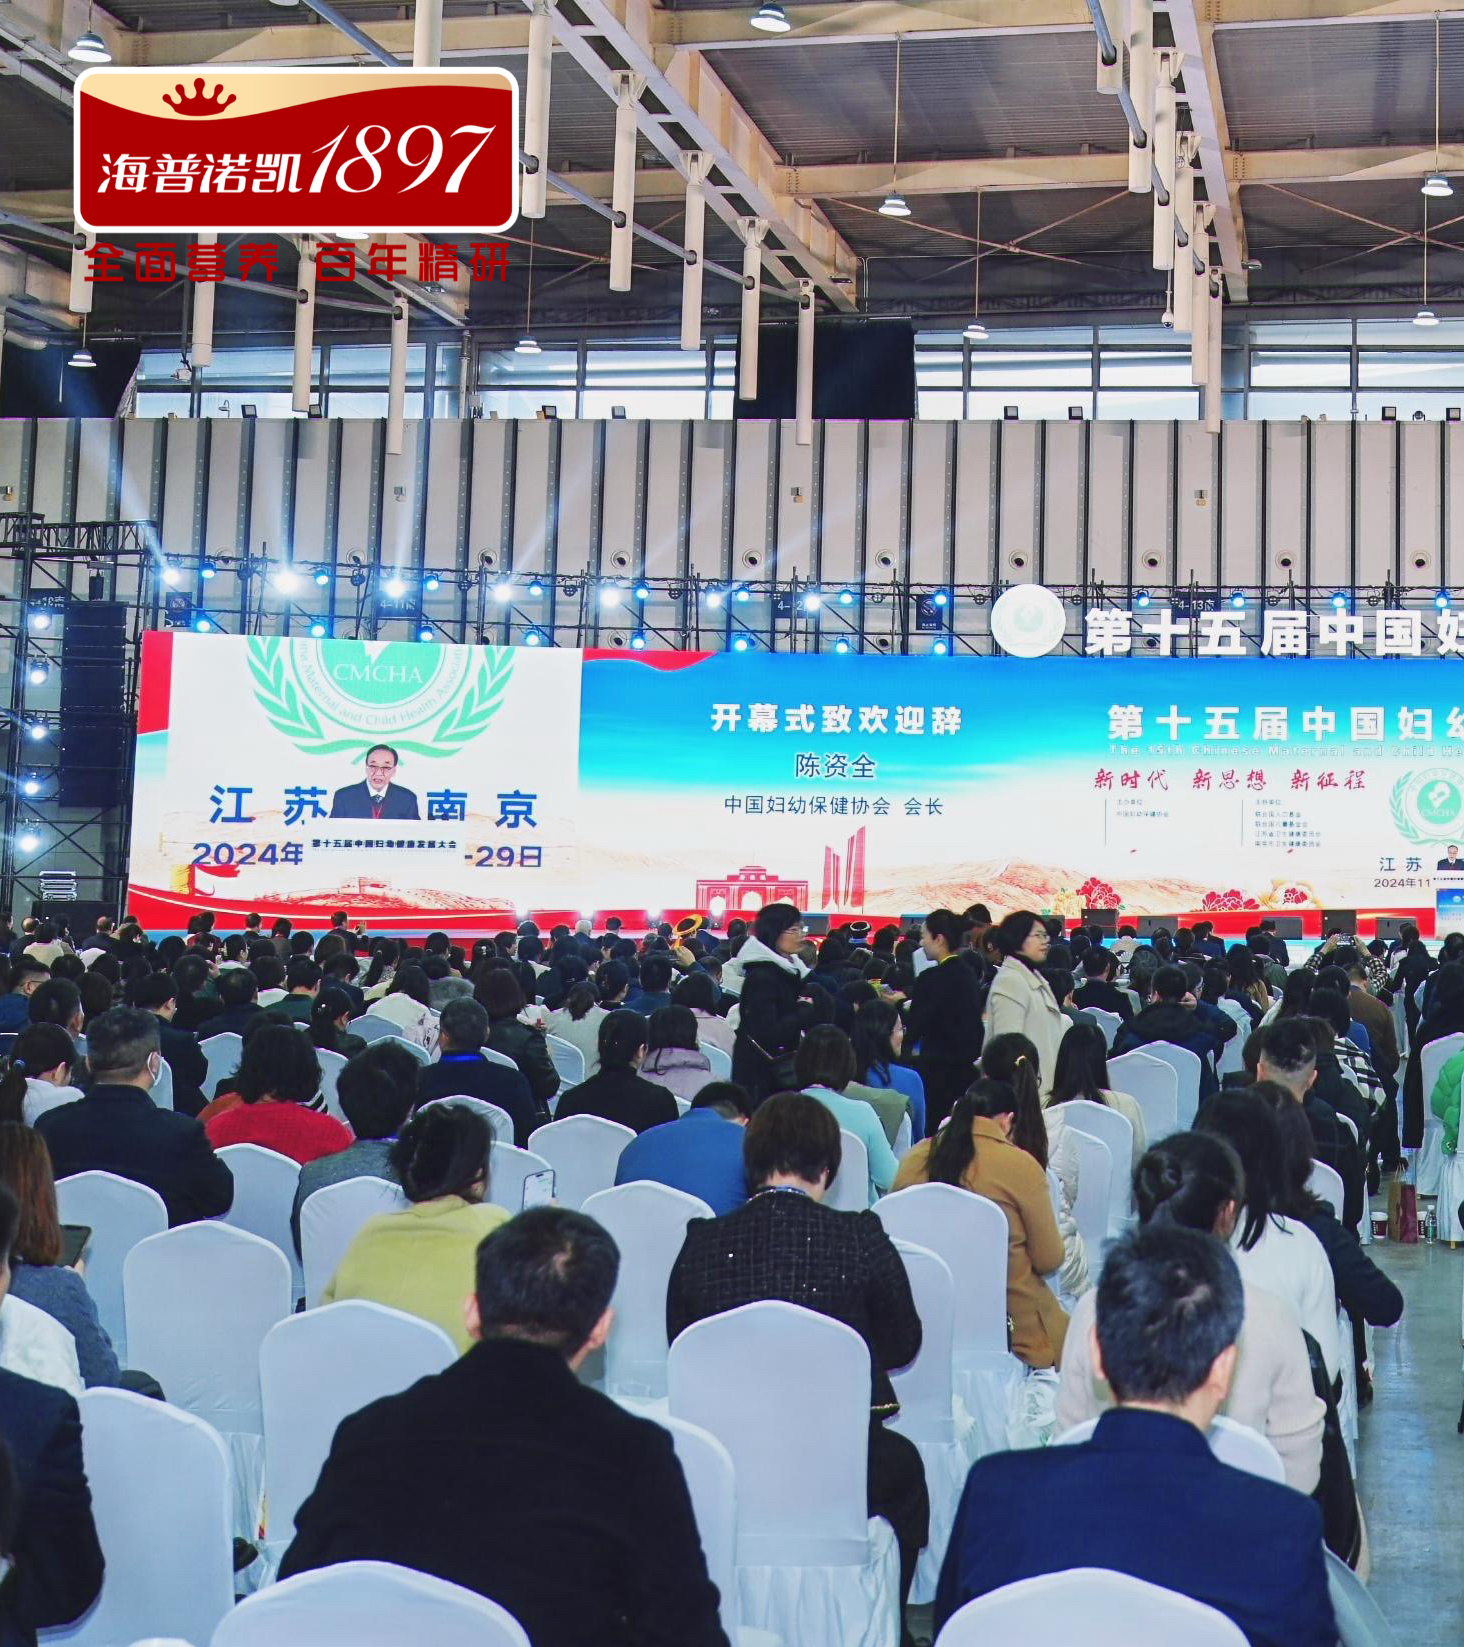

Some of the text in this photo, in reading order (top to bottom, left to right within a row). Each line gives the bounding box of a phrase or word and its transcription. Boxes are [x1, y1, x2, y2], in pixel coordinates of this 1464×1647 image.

[333, 663, 424, 684] CMCHA
[711, 703, 963, 736] 开幕式致欢迎辞
[794, 753, 877, 780] 陈资全
[1093, 768, 1367, 792] 新时代 新思想 新征程
[209, 784, 538, 829] 江苏 南京
[724, 795, 944, 817] 中国妇幼保健协会 会长
[192, 842, 543, 868] 2024年 -29日
[1379, 856, 1423, 873] 江苏
[1374, 877, 1431, 889] 2024年11
